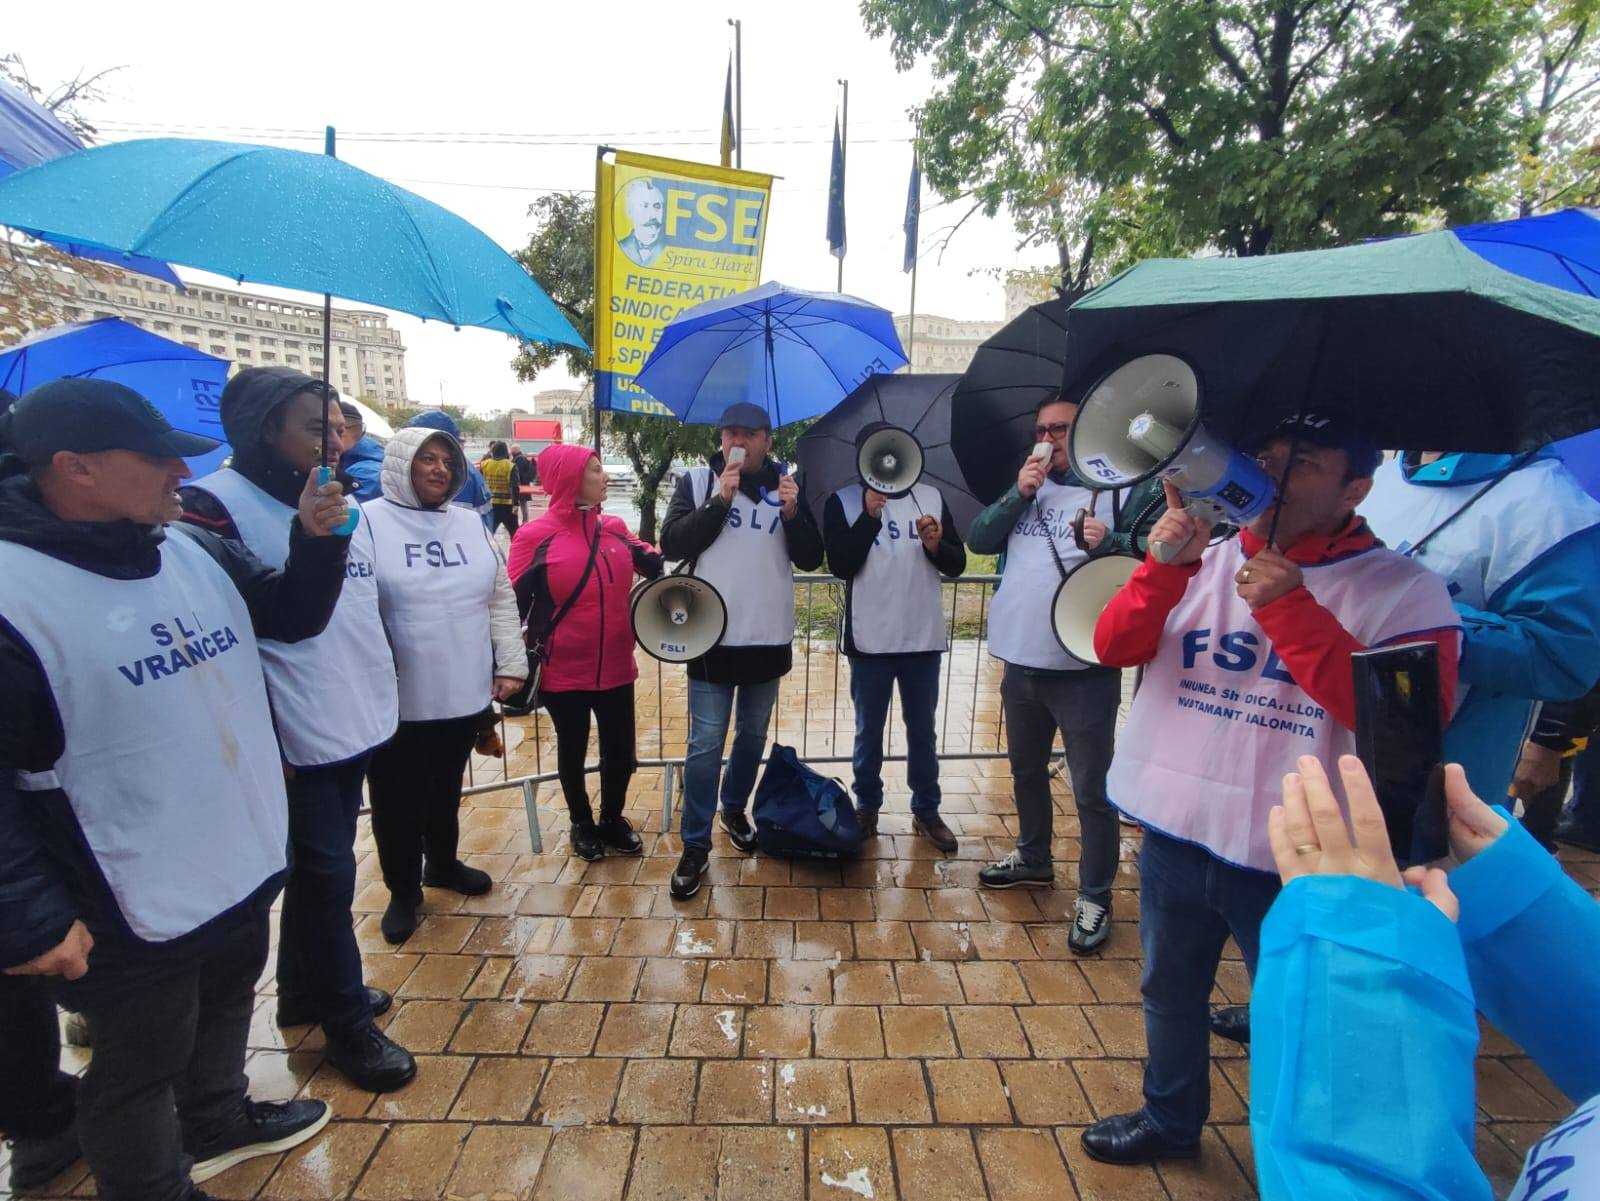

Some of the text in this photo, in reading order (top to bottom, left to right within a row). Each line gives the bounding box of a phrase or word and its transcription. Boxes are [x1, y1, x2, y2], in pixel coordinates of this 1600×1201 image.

[665, 188, 762, 246] FSE
[664, 250, 706, 269] Spiru
[614, 322, 646, 342] DIN
[404, 540, 469, 568] FSLI
[118, 626, 239, 687] VRANCEA
[660, 643, 686, 653] FSLI
[1245, 712, 1316, 739] IALOMITA
